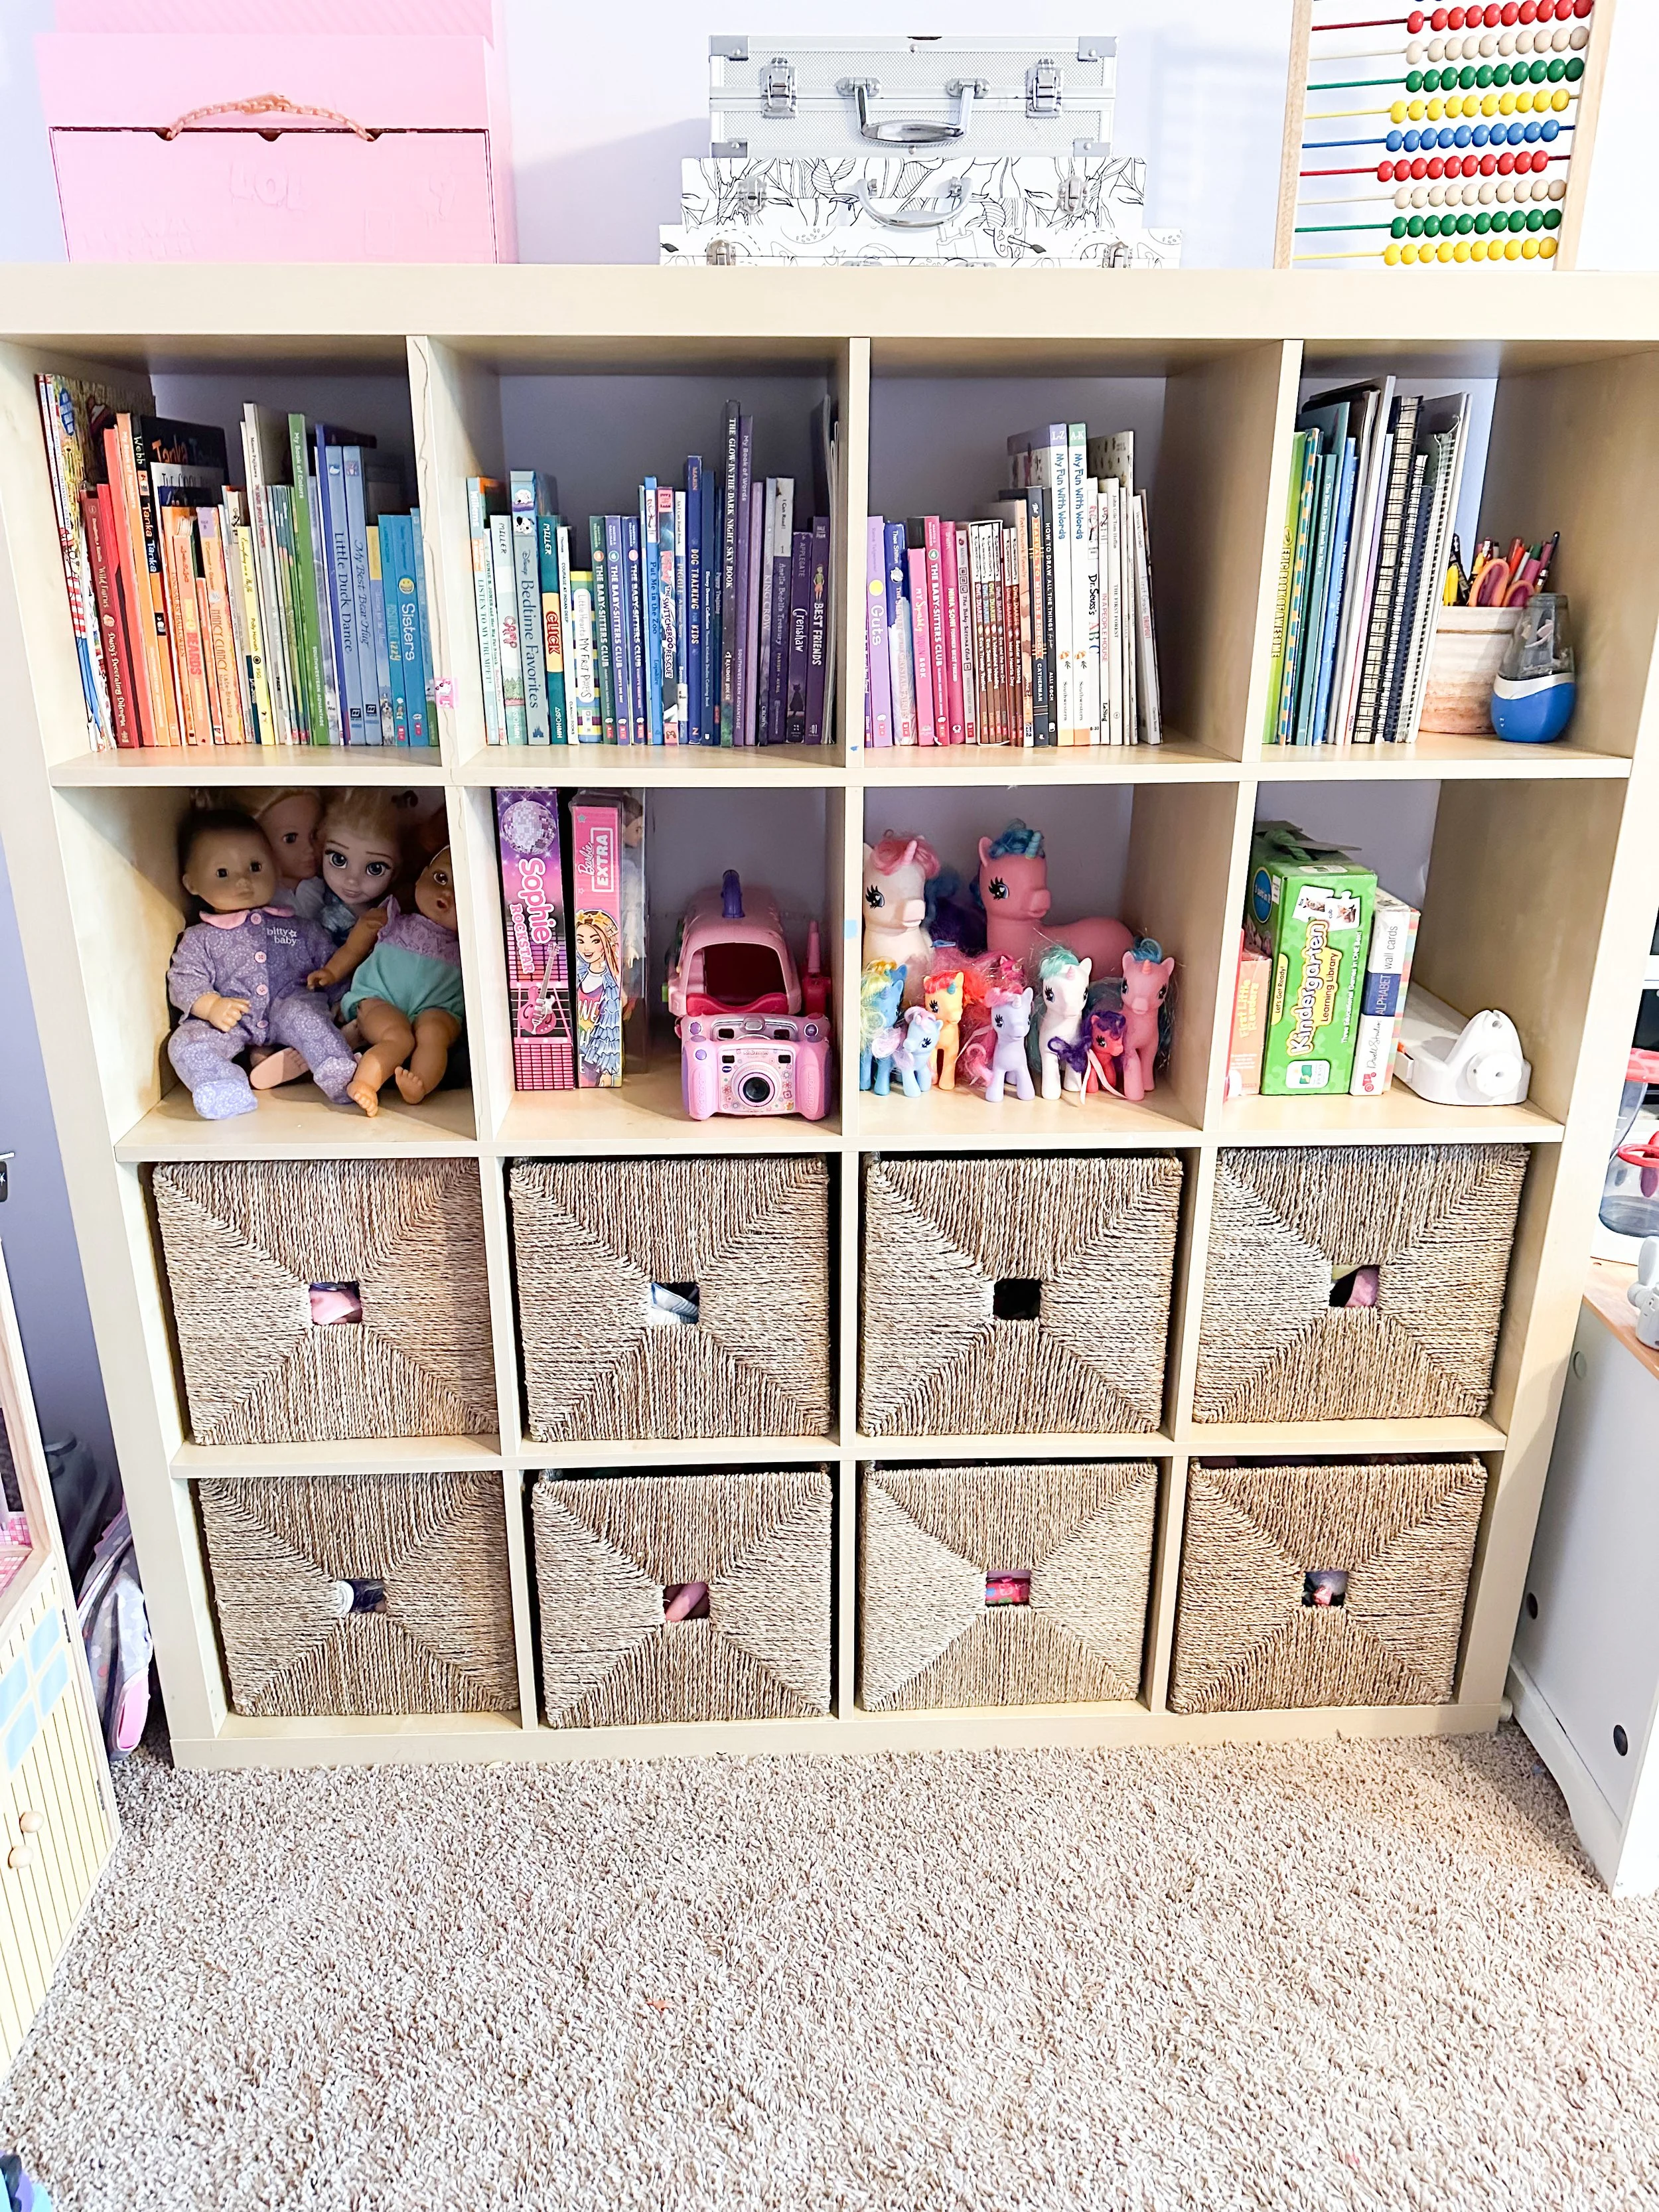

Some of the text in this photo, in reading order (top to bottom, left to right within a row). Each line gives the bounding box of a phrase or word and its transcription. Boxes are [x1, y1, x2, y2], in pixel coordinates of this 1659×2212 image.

[133, 435, 145, 464] Webb
[293, 433, 299, 443] My
[742, 435, 749, 445] My
[1051, 430, 1066, 441] L-Z
[1070, 430, 1085, 441] A-K
[1054, 453, 1067, 540] My Fun With Words
[1073, 453, 1084, 540] My Fun With Words
[142, 503, 157, 572] Tanka Tanka
[651, 579, 658, 590] Me
[1035, 564, 1040, 576] TO
[334, 533, 352, 653] Little Duck Dance
[354, 540, 371, 648] My Best Bear Hug
[596, 584, 608, 642] BABY-SITTERS
[611, 584, 622, 644] BABY-SITTERS
[631, 583, 640, 642] BABY-SITTERS
[652, 592, 658, 601] in
[932, 583, 942, 642] BABY-SITTERS
[1271, 548, 1291, 657] EPIC BOOK OF AWESOME
[401, 603, 416, 661] Sisters
[480, 613, 486, 623] TO
[481, 627, 488, 637] MY
[502, 616, 518, 648] CAMP
[521, 550, 541, 708] Disney Bedtime Favorites
[546, 611, 561, 655] CLICK
[662, 597, 674, 648] SWITCHEROO
[792, 608, 808, 652] Crenshaw
[871, 605, 885, 646] Guts
[186, 632, 201, 675] BEARDS
[210, 610, 227, 671] NANCY CLANCY
[482, 640, 491, 684] TRUMPET!
[313, 646, 321, 692] SOUTHWESTERN
[664, 650, 673, 678] RESCUE!
[578, 839, 595, 880] Barbie
[597, 834, 609, 887] EXTRA
[518, 857, 557, 945] Sophie
[267, 927, 288, 936] bitty
[274, 936, 297, 946] baby
[509, 903, 536, 975] ROCKSTAR
[1384, 926, 1398, 970] wall cards
[1289, 923, 1325, 1053] Kindergarten
[1321, 953, 1338, 1022] Learning Library
[1348, 968, 1357, 990] Games
[1375, 974, 1392, 1015] ALPHABET
[1237, 980, 1251, 1037] First Little
[1247, 982, 1260, 1031] Readers
[1344, 992, 1354, 1025] Educational
